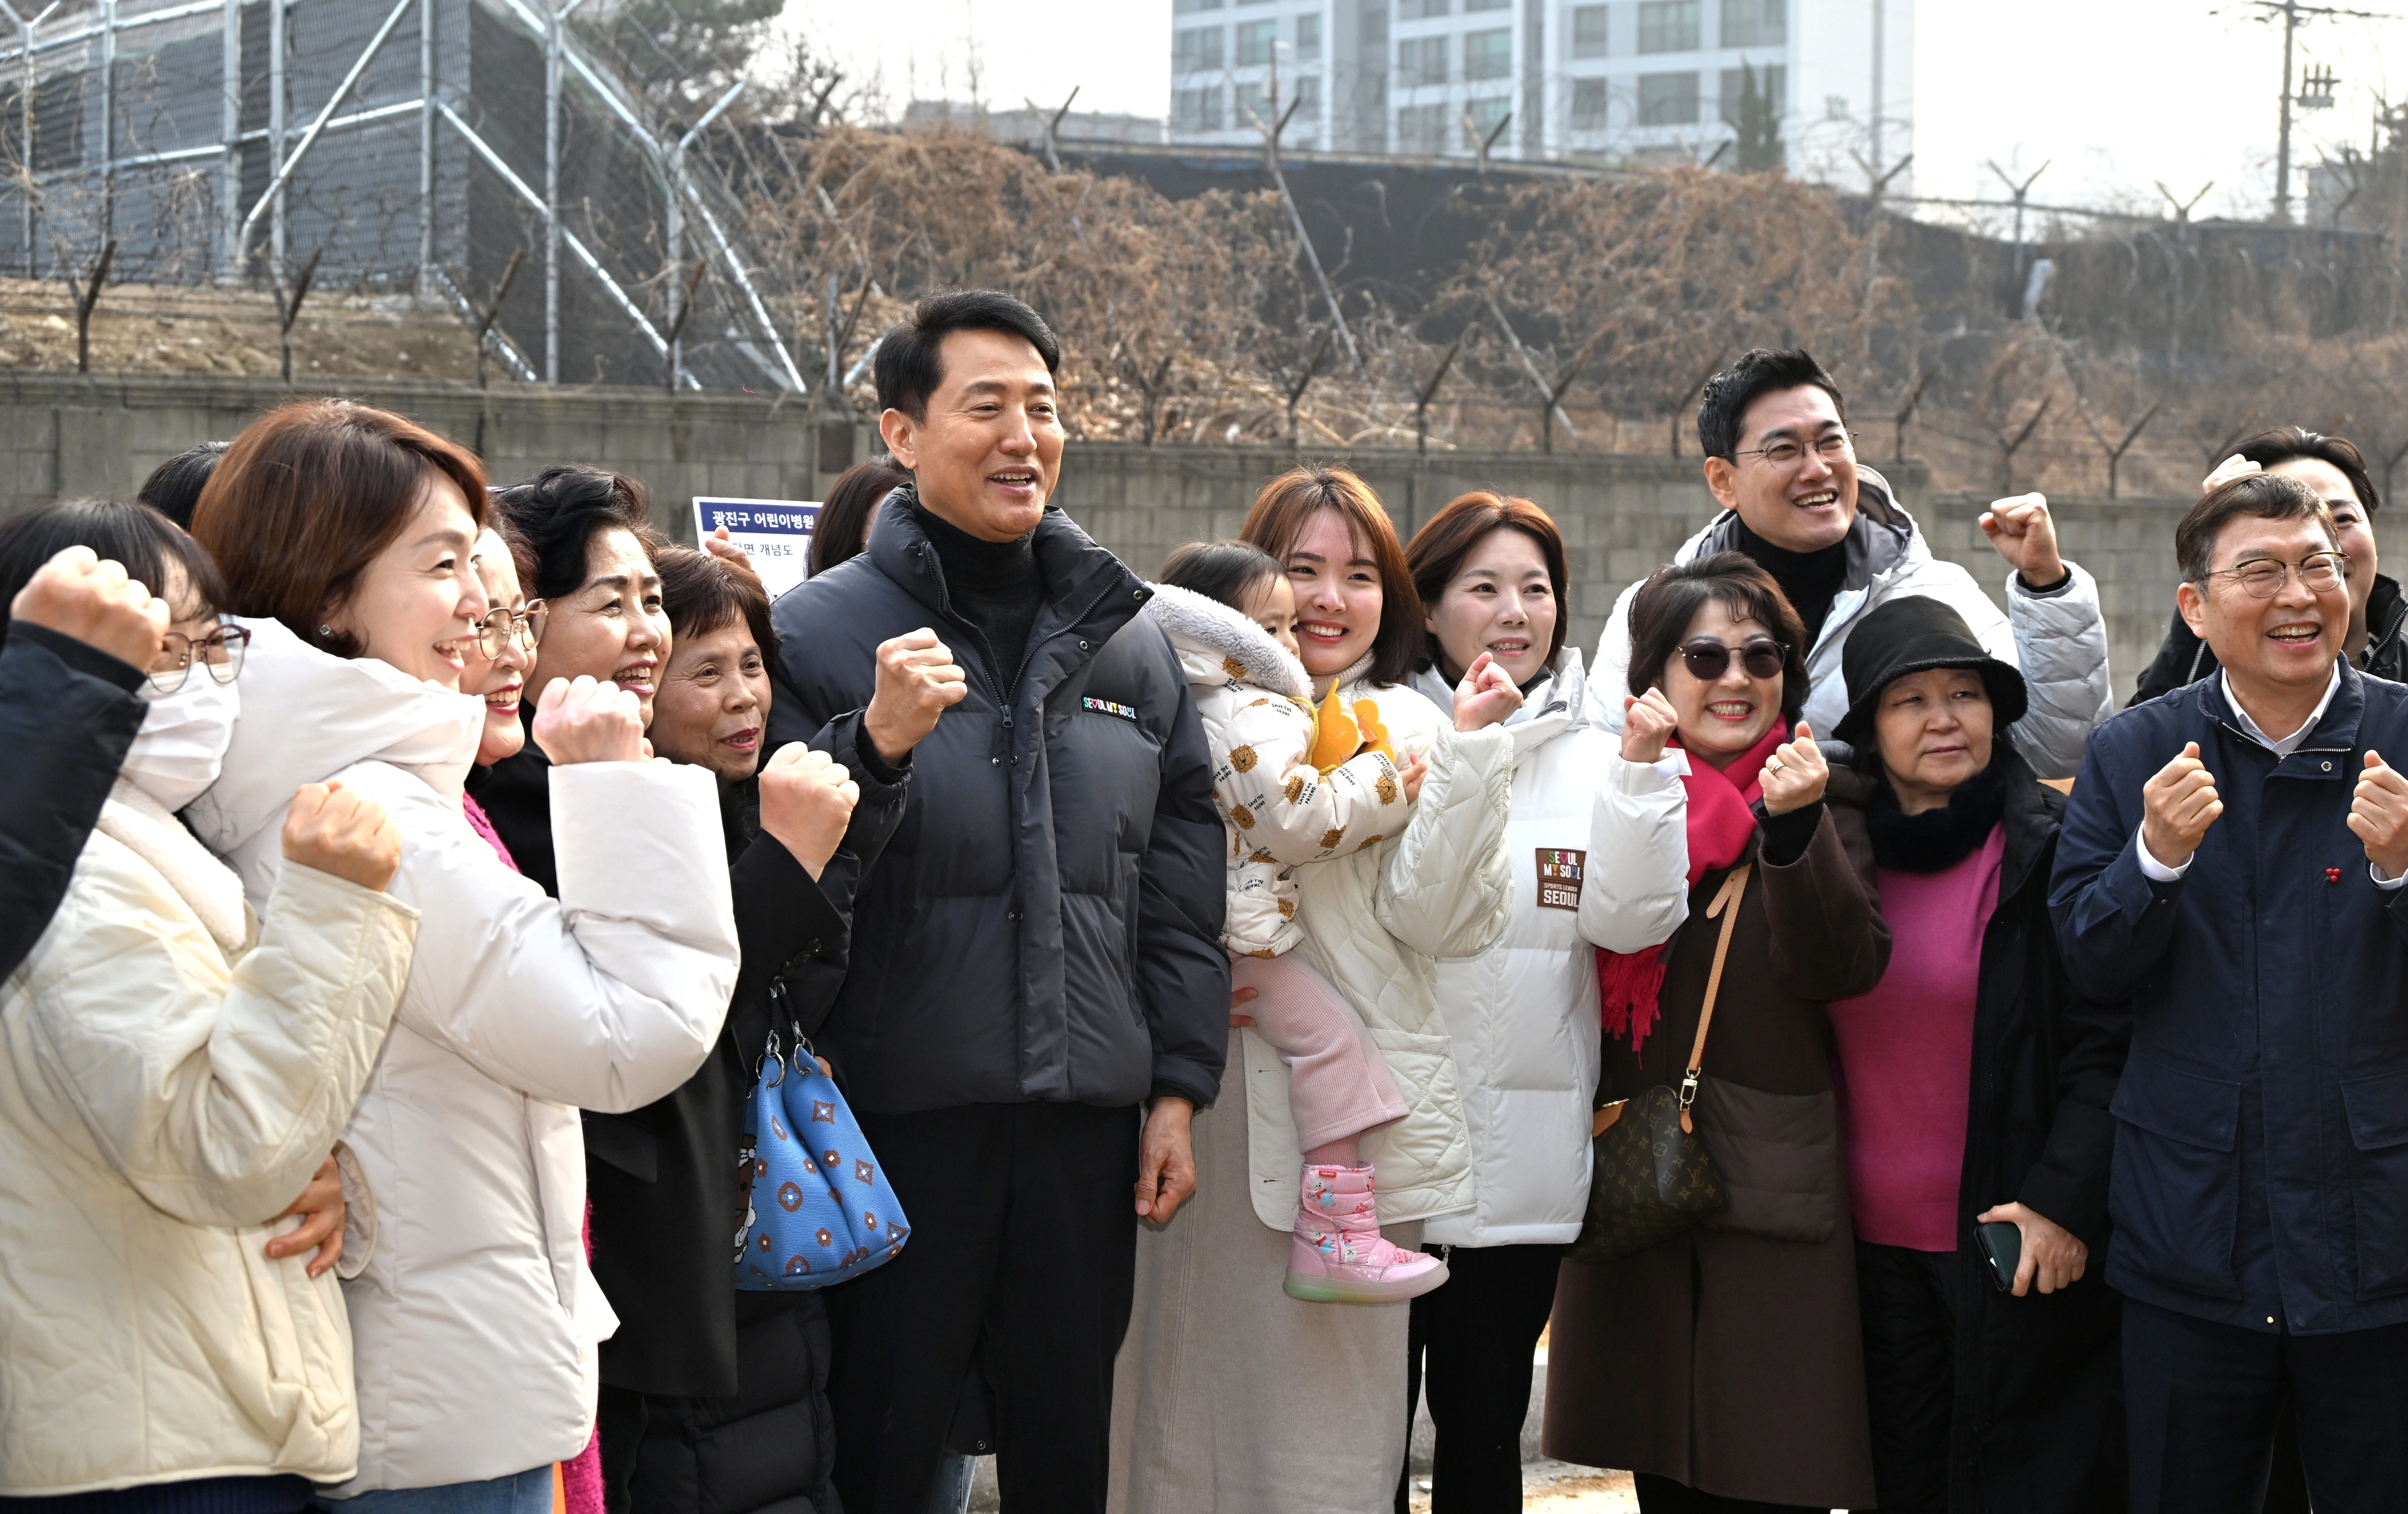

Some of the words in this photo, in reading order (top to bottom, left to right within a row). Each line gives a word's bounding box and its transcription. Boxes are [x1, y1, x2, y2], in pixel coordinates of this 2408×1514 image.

[712, 510, 750, 527] 광진구
[754, 512, 814, 529] 어린이병원
[760, 544, 793, 556] 개념도
[1118, 704, 1137, 719] SOUL
[1277, 709, 1291, 717] FRIEND
[1220, 765, 1229, 773] THE
[1345, 775, 1356, 786] SAVE
[1298, 792, 1307, 805] SAVE
[1304, 782, 1313, 792] THE
[1305, 786, 1317, 804] FRIEND
[1247, 798, 1258, 808] SAVE
[1254, 800, 1265, 811] FRIEND
[1560, 864, 1581, 880] SOUL
[1544, 889, 1578, 908] SEOUL
